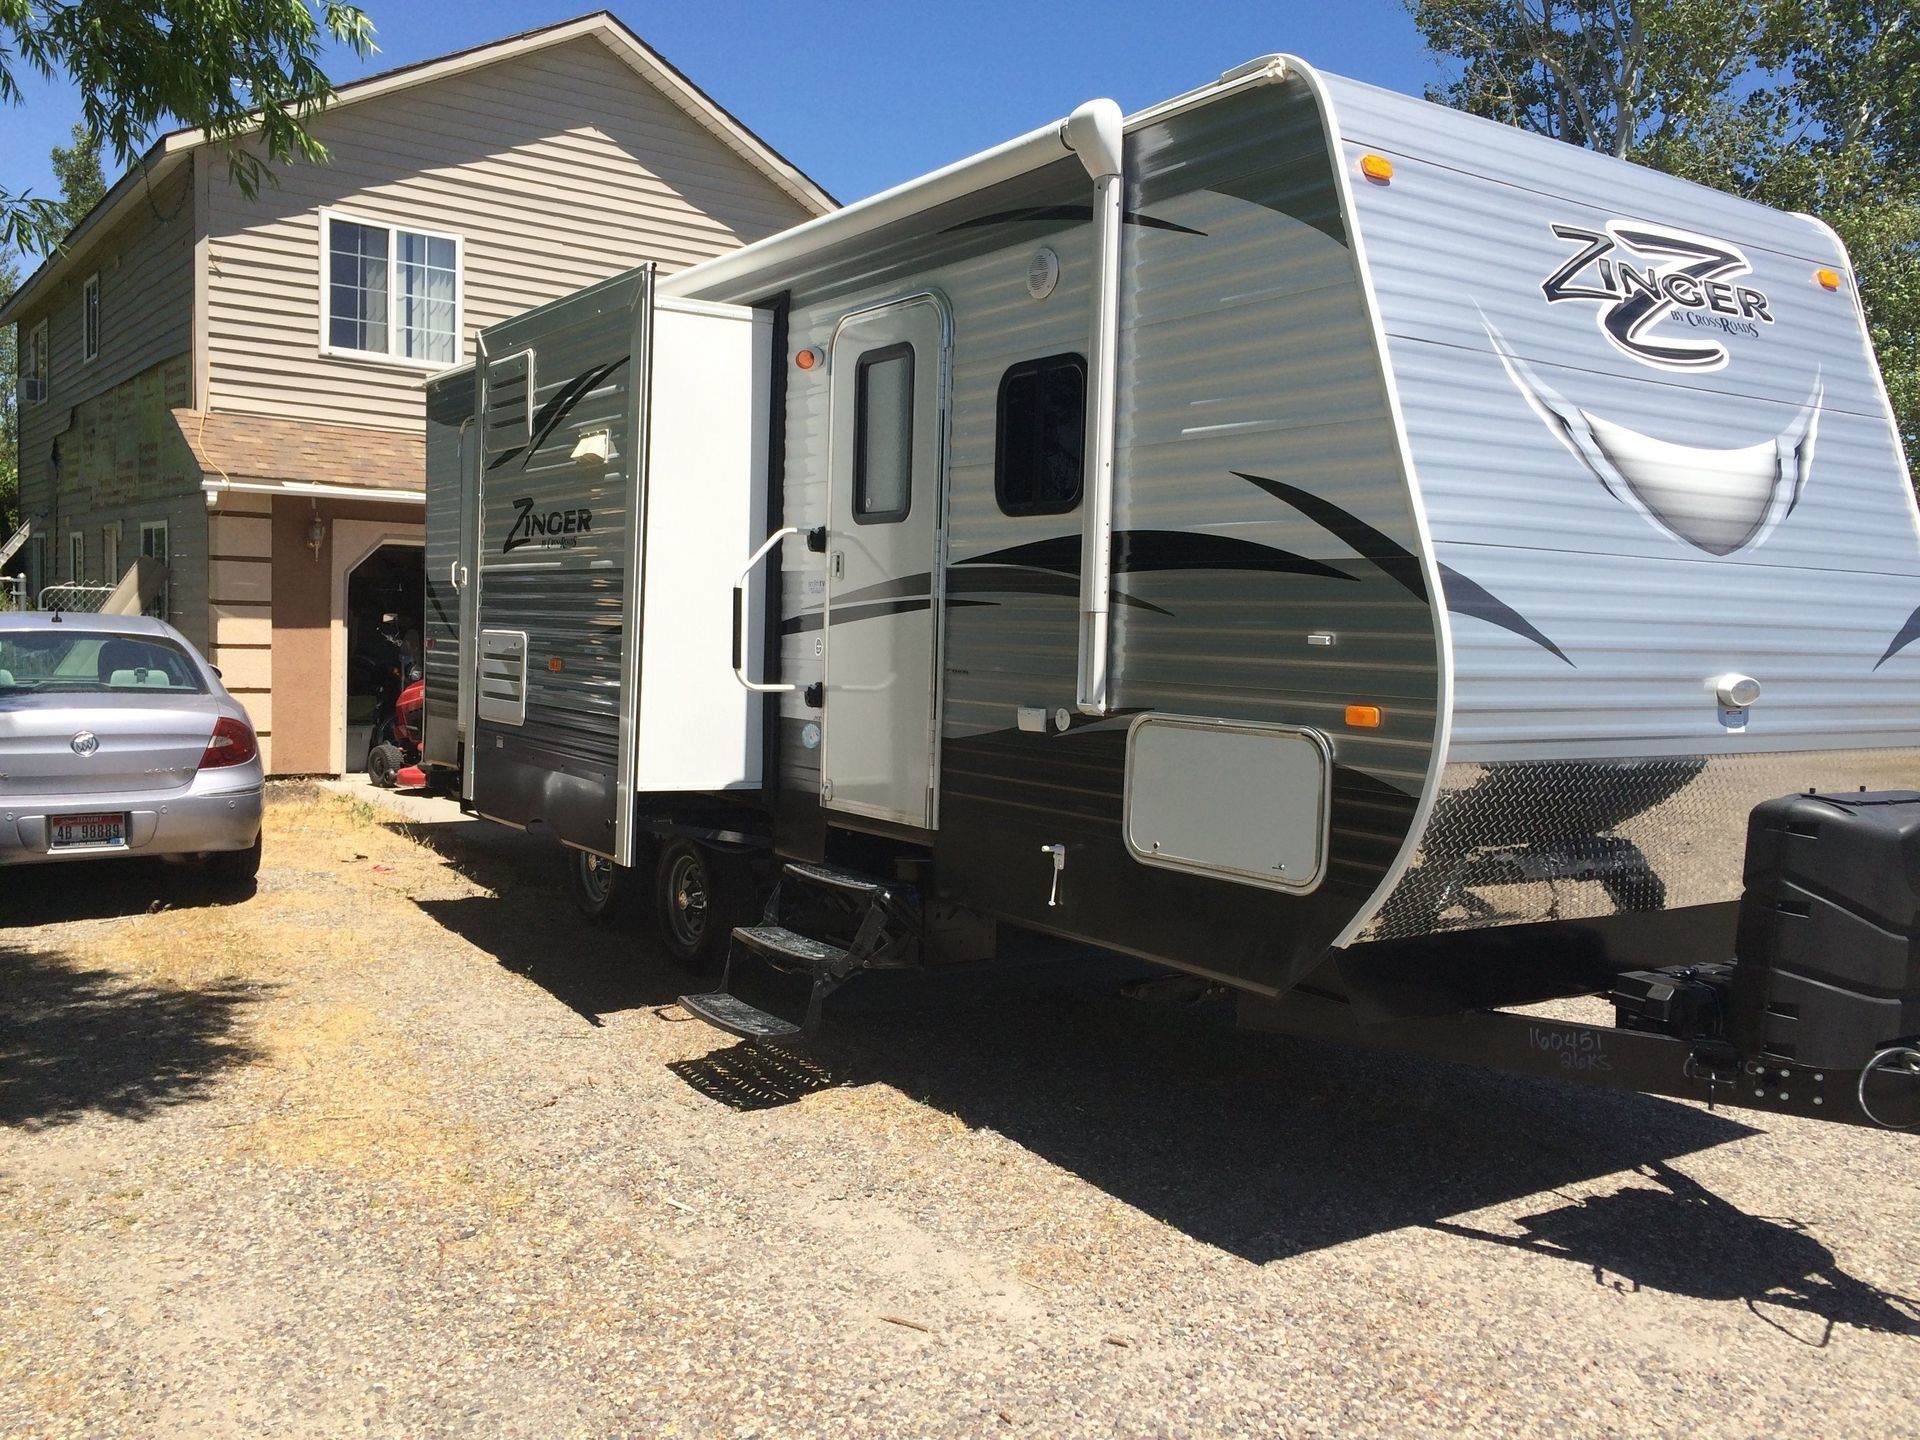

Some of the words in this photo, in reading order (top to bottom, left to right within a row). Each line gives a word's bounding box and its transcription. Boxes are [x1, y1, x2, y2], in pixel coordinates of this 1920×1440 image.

[1541, 223, 1775, 323] ZINGER
[1670, 310, 1685, 322] BY
[503, 497, 593, 554] ZINGER
[57, 826, 73, 840] 4B
[1529, 1027, 1602, 1052] 160451
